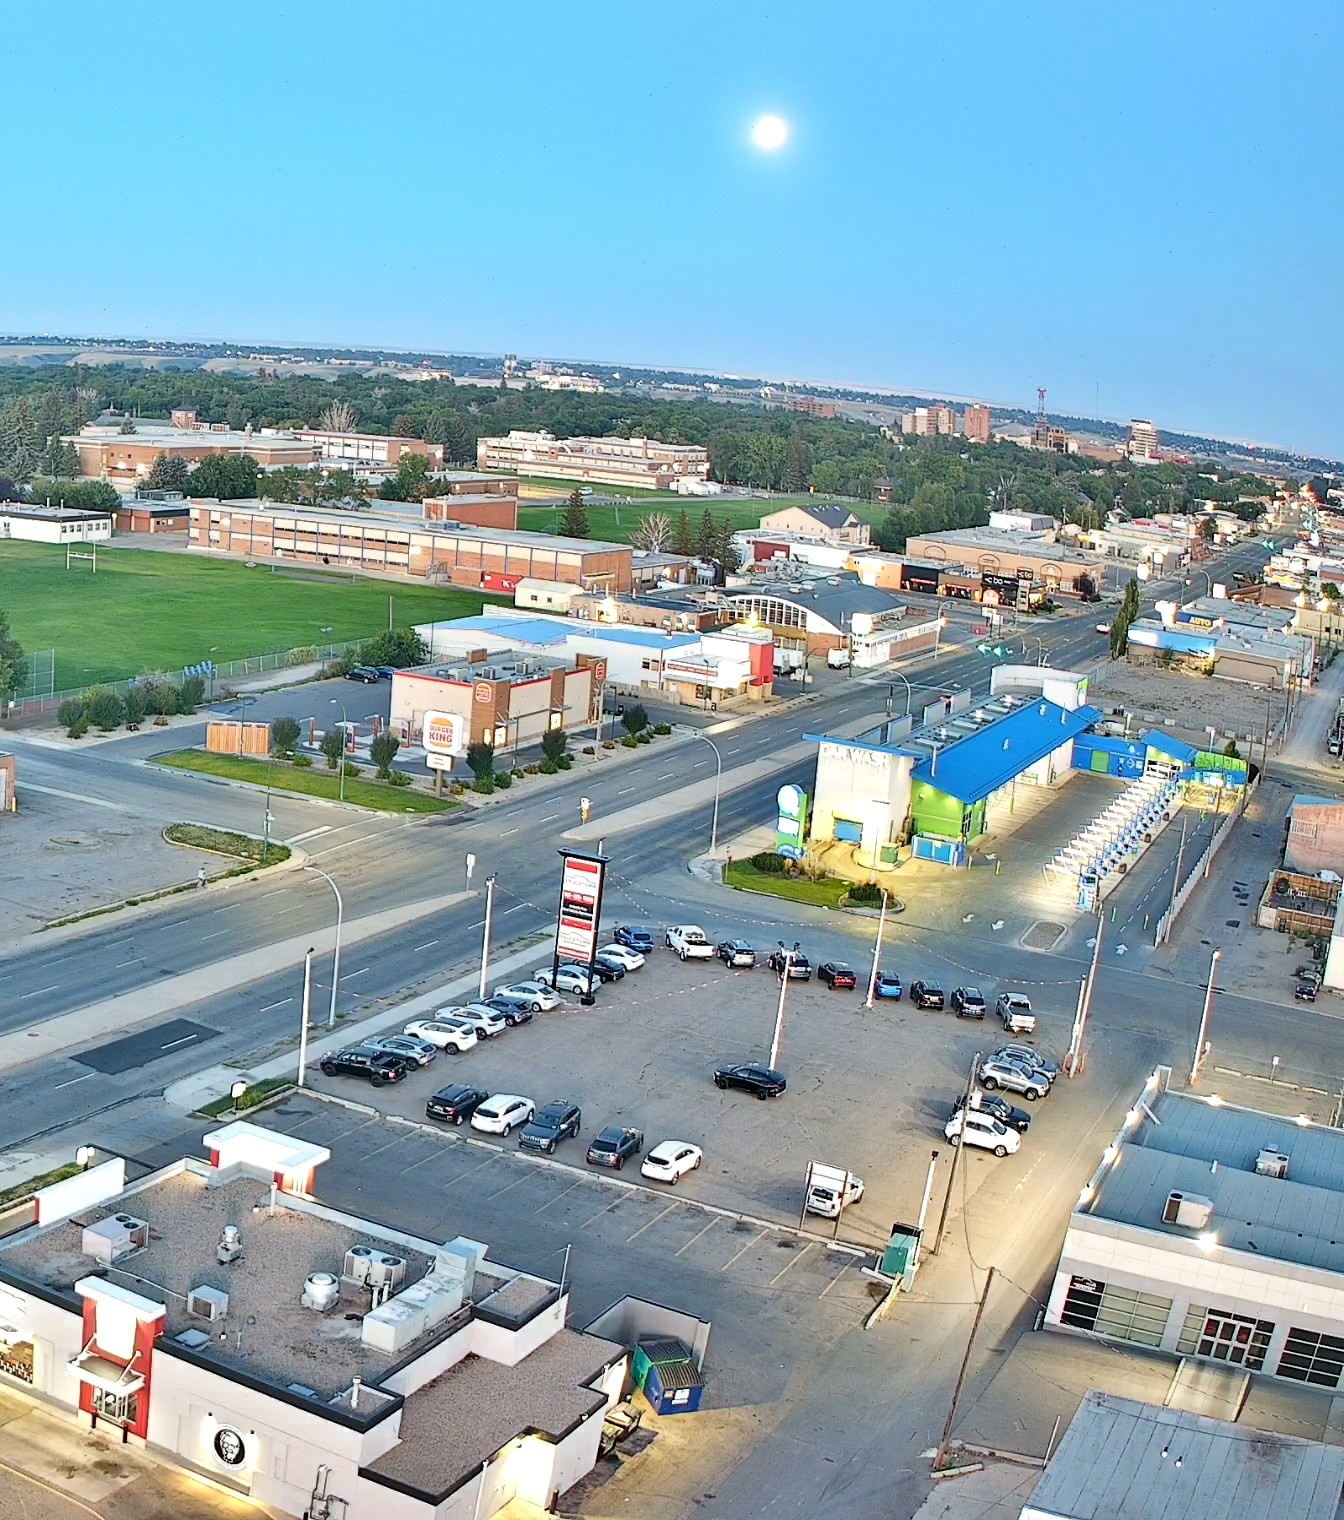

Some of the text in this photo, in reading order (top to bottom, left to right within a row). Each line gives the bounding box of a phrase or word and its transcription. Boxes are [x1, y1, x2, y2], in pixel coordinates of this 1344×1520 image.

[1189, 616, 1212, 627] AUTO
[429, 724, 454, 735] BURGER
[429, 732, 453, 743] KING
